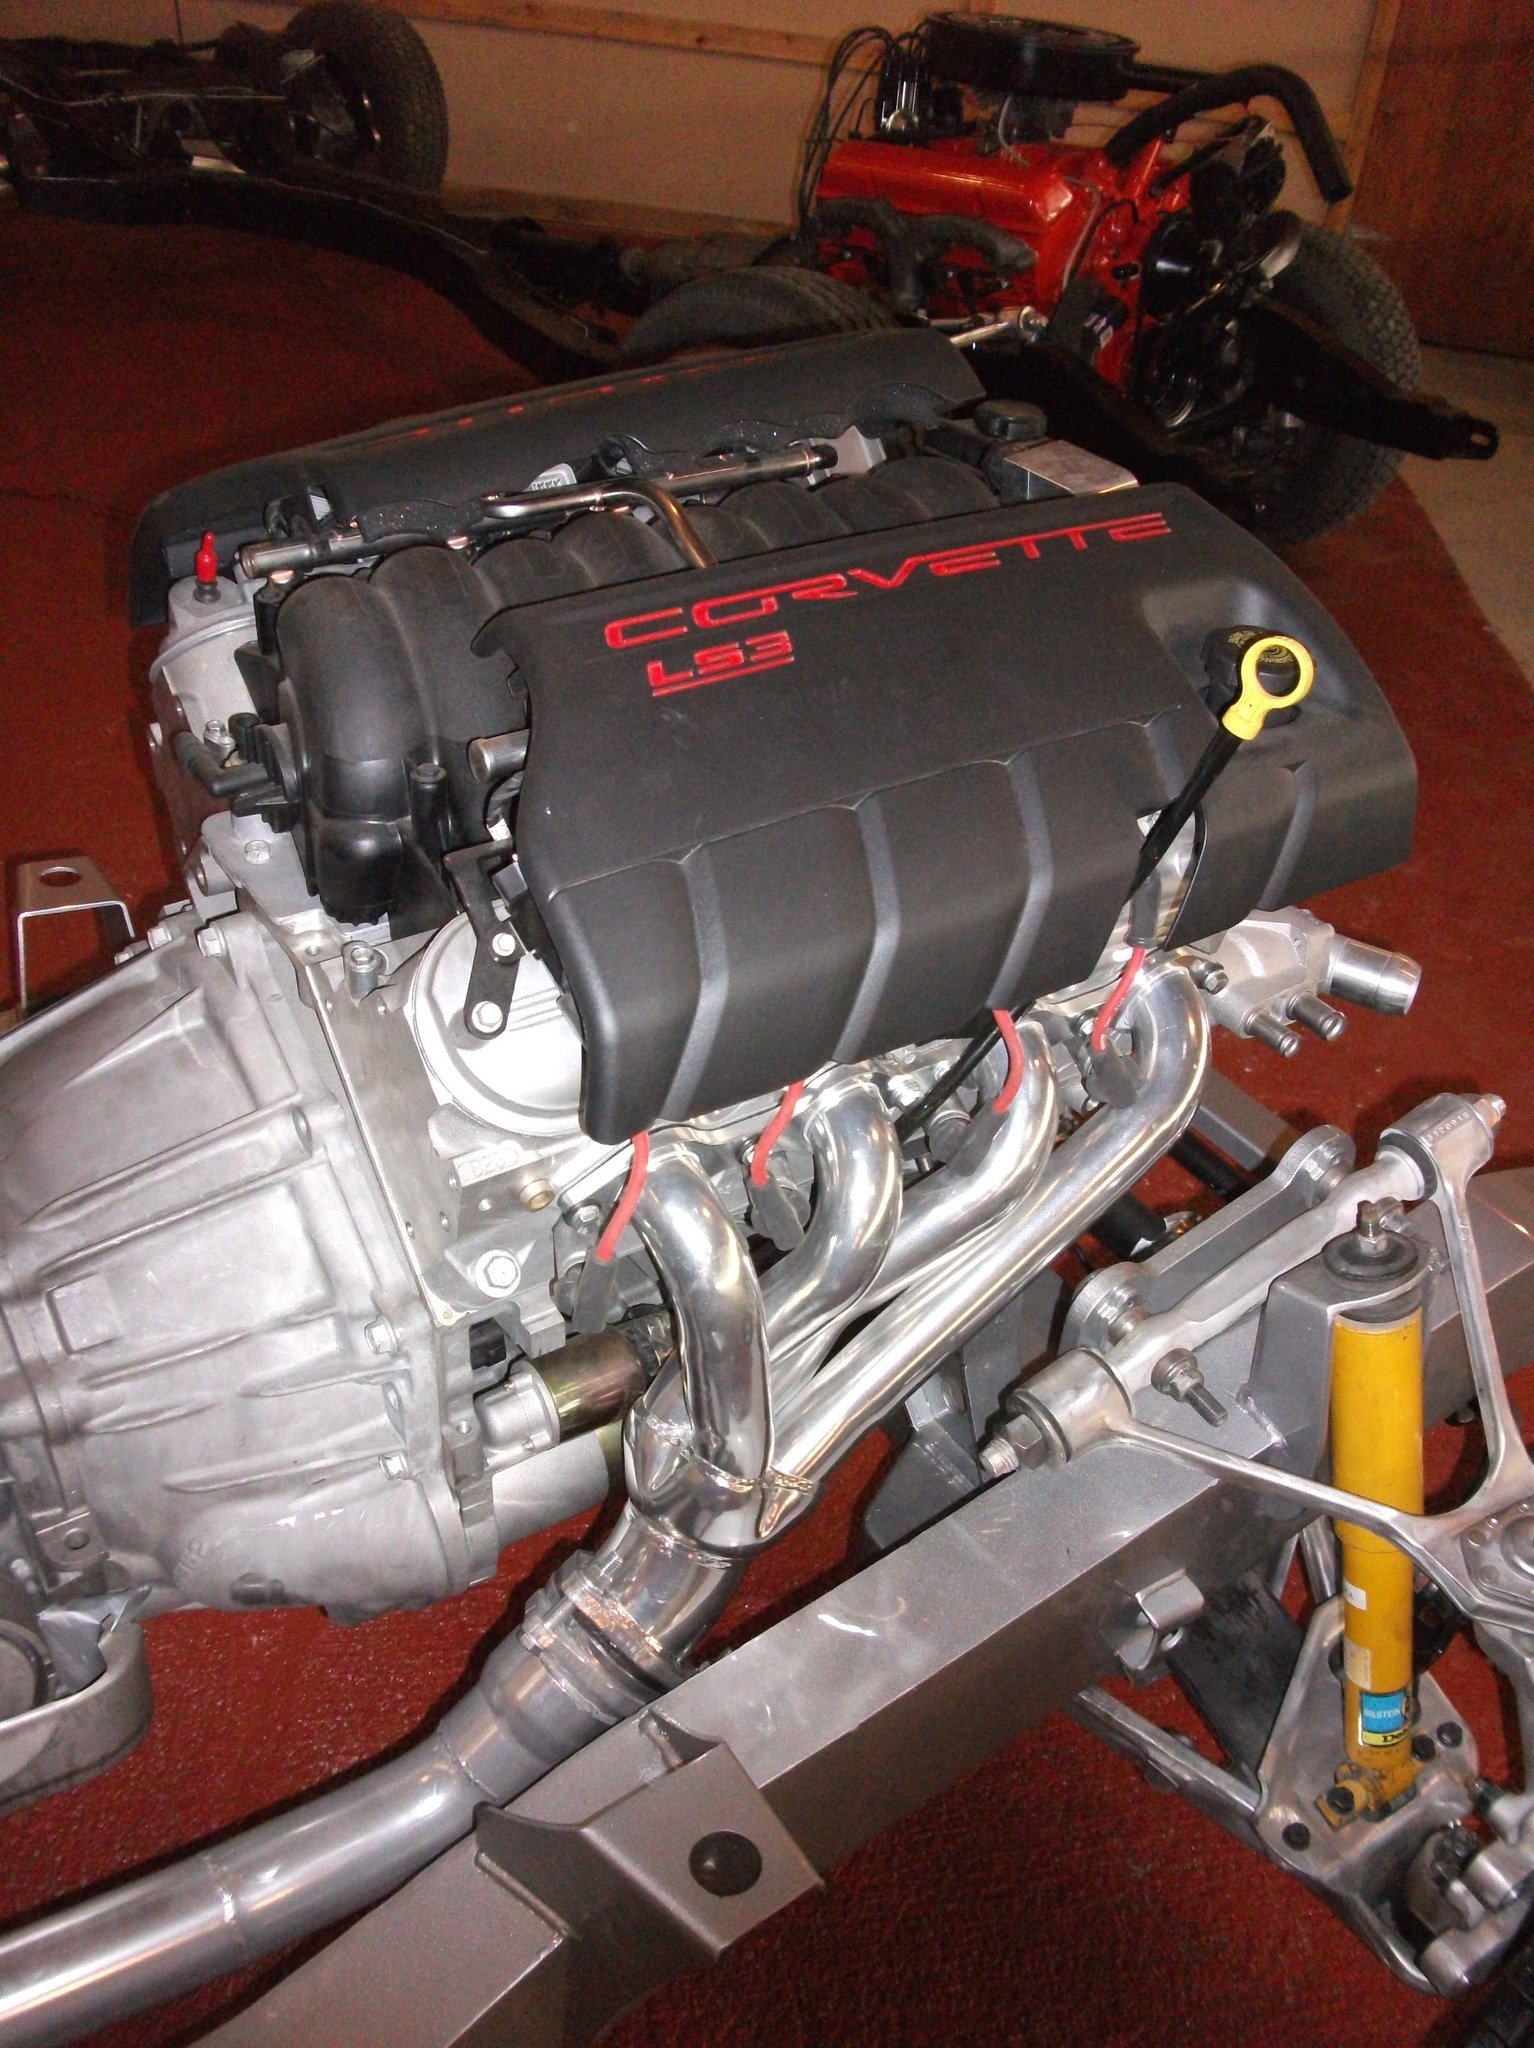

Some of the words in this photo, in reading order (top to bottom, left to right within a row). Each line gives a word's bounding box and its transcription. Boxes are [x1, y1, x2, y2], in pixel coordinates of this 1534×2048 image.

[604, 512, 1172, 649] CORVETTE
[646, 629, 793, 688] LS3
[1363, 1707, 1402, 1719] BILSTEIN
